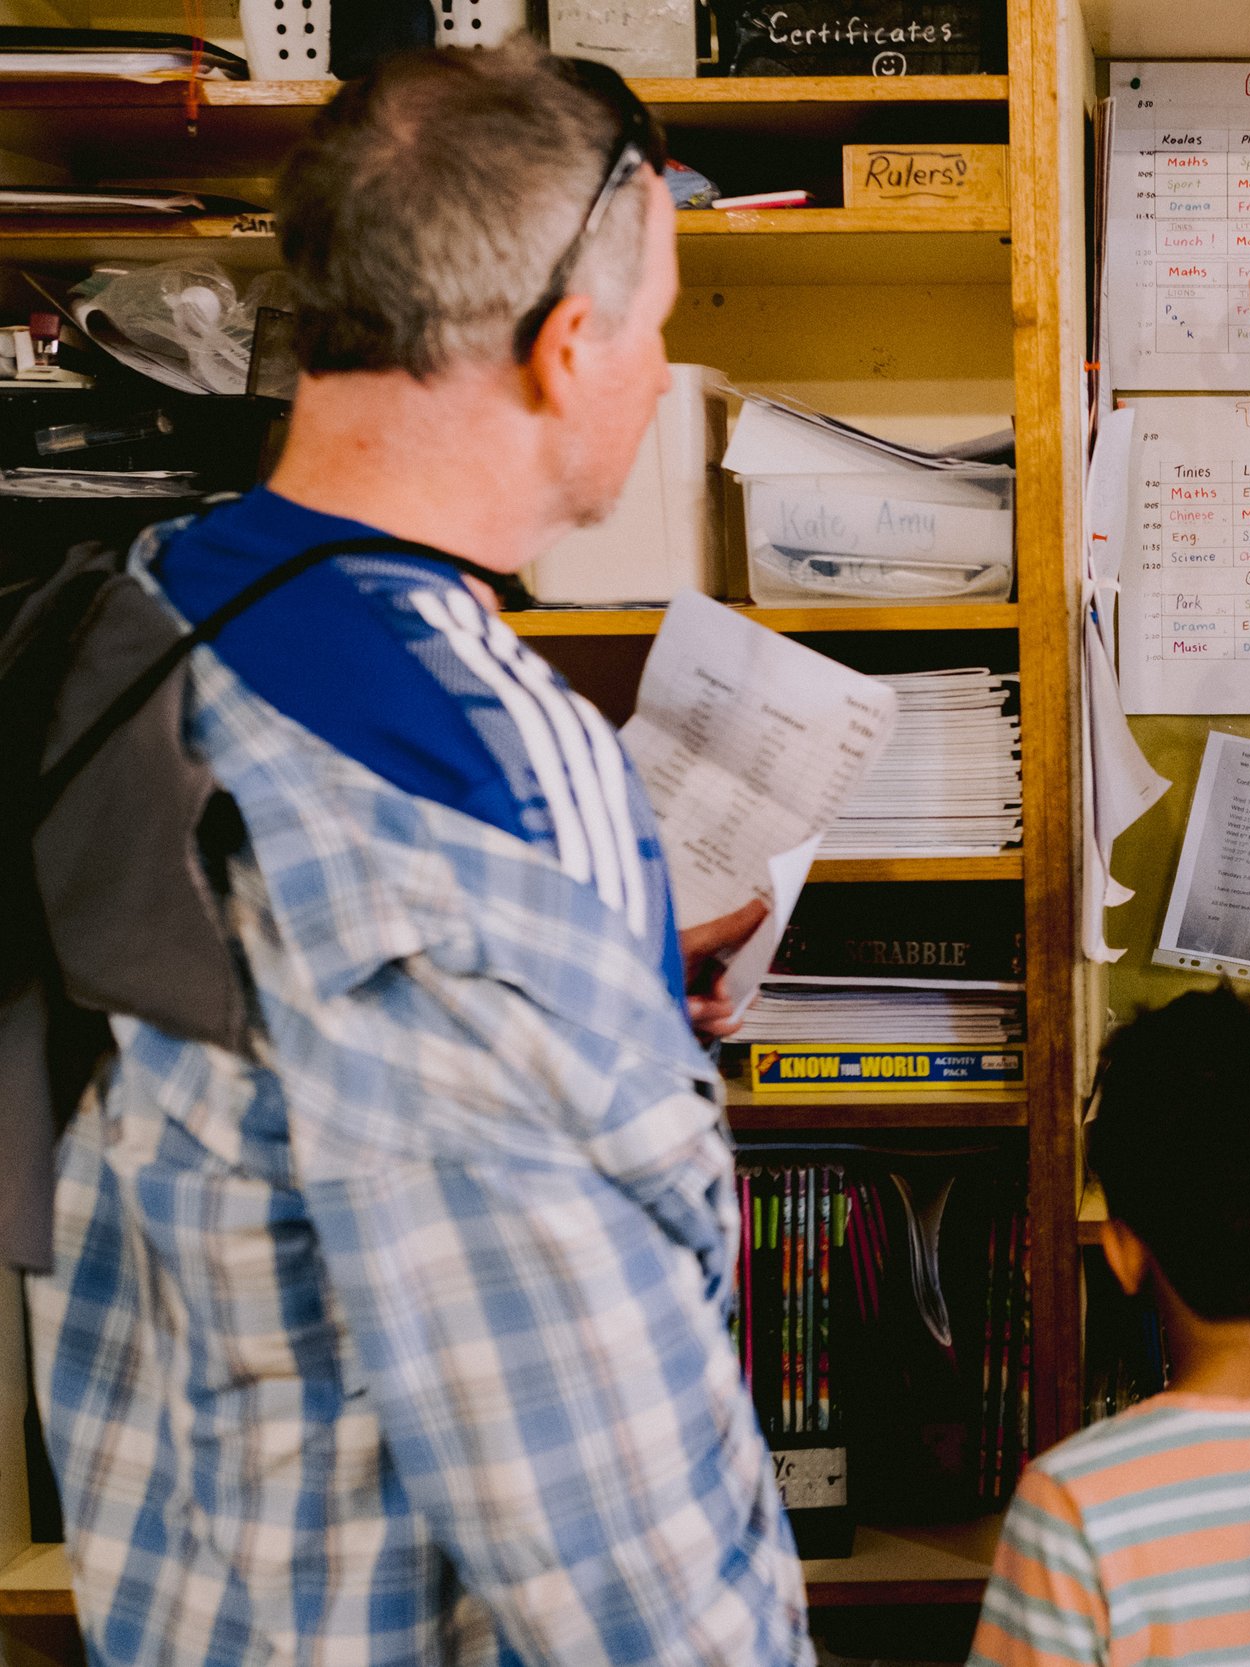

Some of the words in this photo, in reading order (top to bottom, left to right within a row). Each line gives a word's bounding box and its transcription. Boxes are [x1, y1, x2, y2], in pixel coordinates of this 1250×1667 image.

[769, 11, 952, 45] Certificates
[1162, 134, 1203, 145] Koalas
[865, 155, 967, 189] Rulers!
[1165, 237, 1203, 247] Lunch
[1169, 267, 1207, 276] Maths
[1174, 464, 1211, 478] Tinies
[1172, 488, 1217, 499] Maths
[877, 502, 936, 550] Amy
[1176, 594, 1202, 611] Park
[1173, 642, 1208, 653] Music
[935, 1056, 976, 1066] ACTIVITY
[780, 1057, 840, 1079] KNOW
[861, 1056, 930, 1078] WORLD
[943, 1068, 968, 1077] PACK
